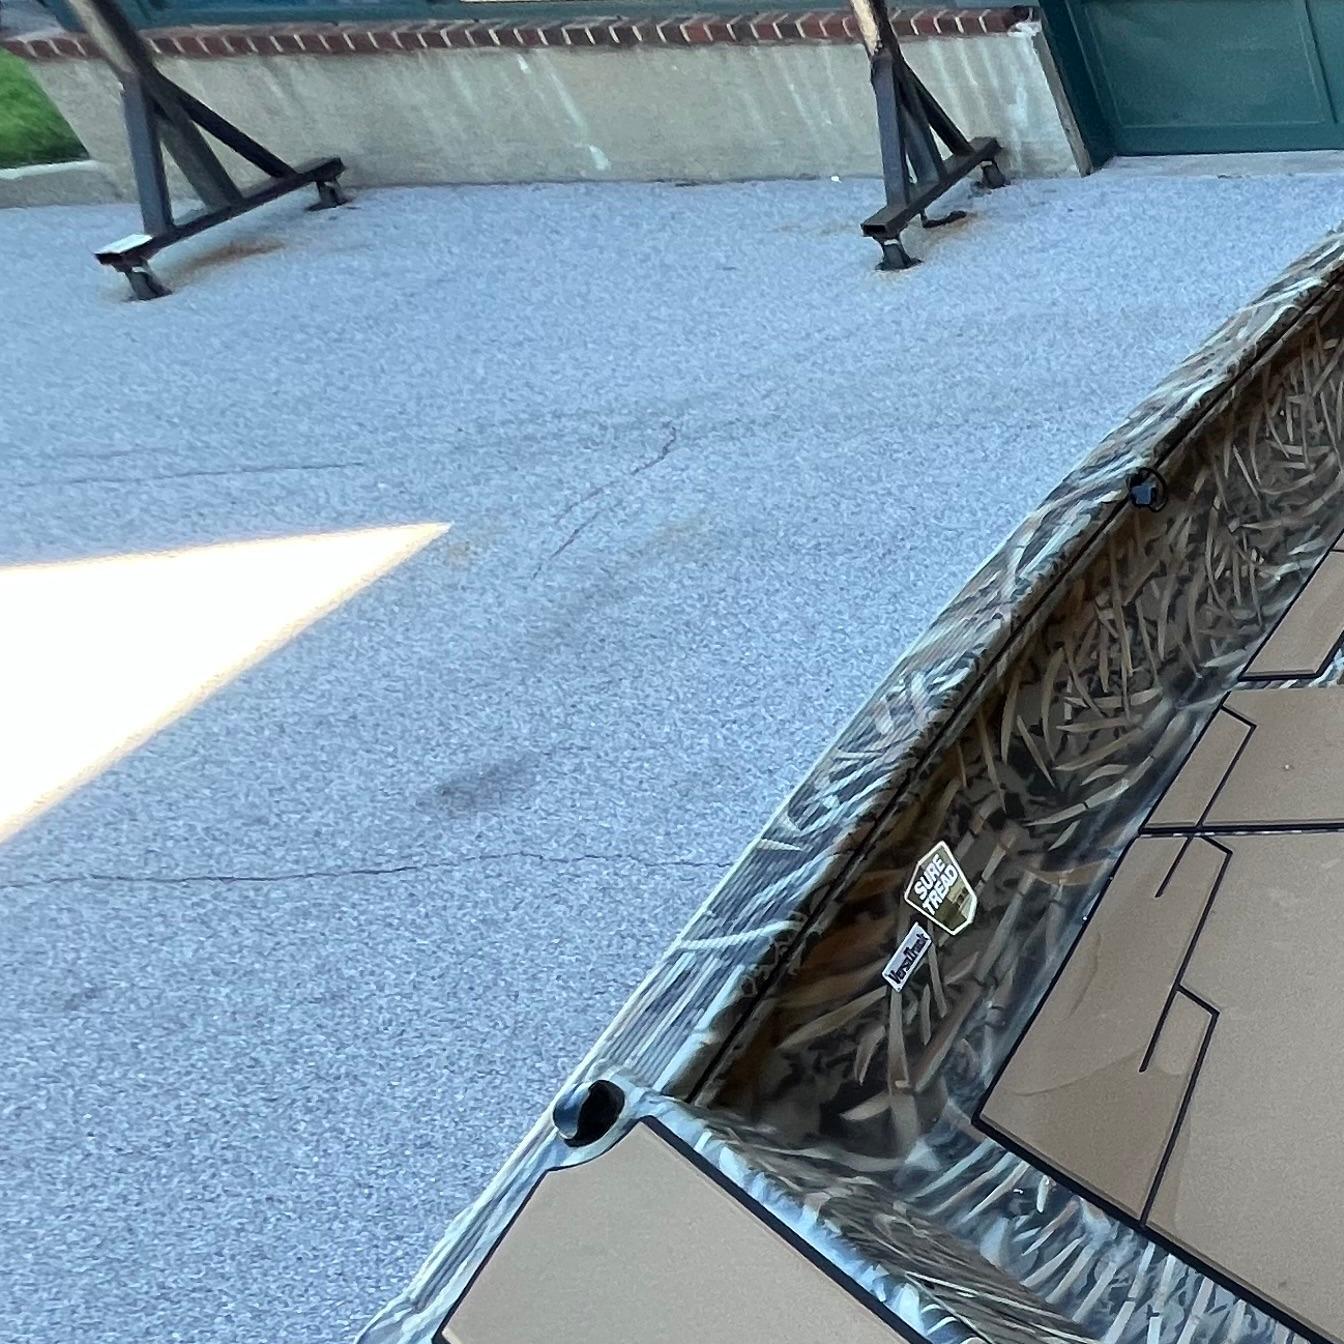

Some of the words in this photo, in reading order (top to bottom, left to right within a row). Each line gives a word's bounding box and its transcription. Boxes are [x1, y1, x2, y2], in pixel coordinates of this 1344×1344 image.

[914, 854, 946, 900] SURE
[922, 864, 959, 916] TREAD
[888, 933, 928, 984] VersaTrack
